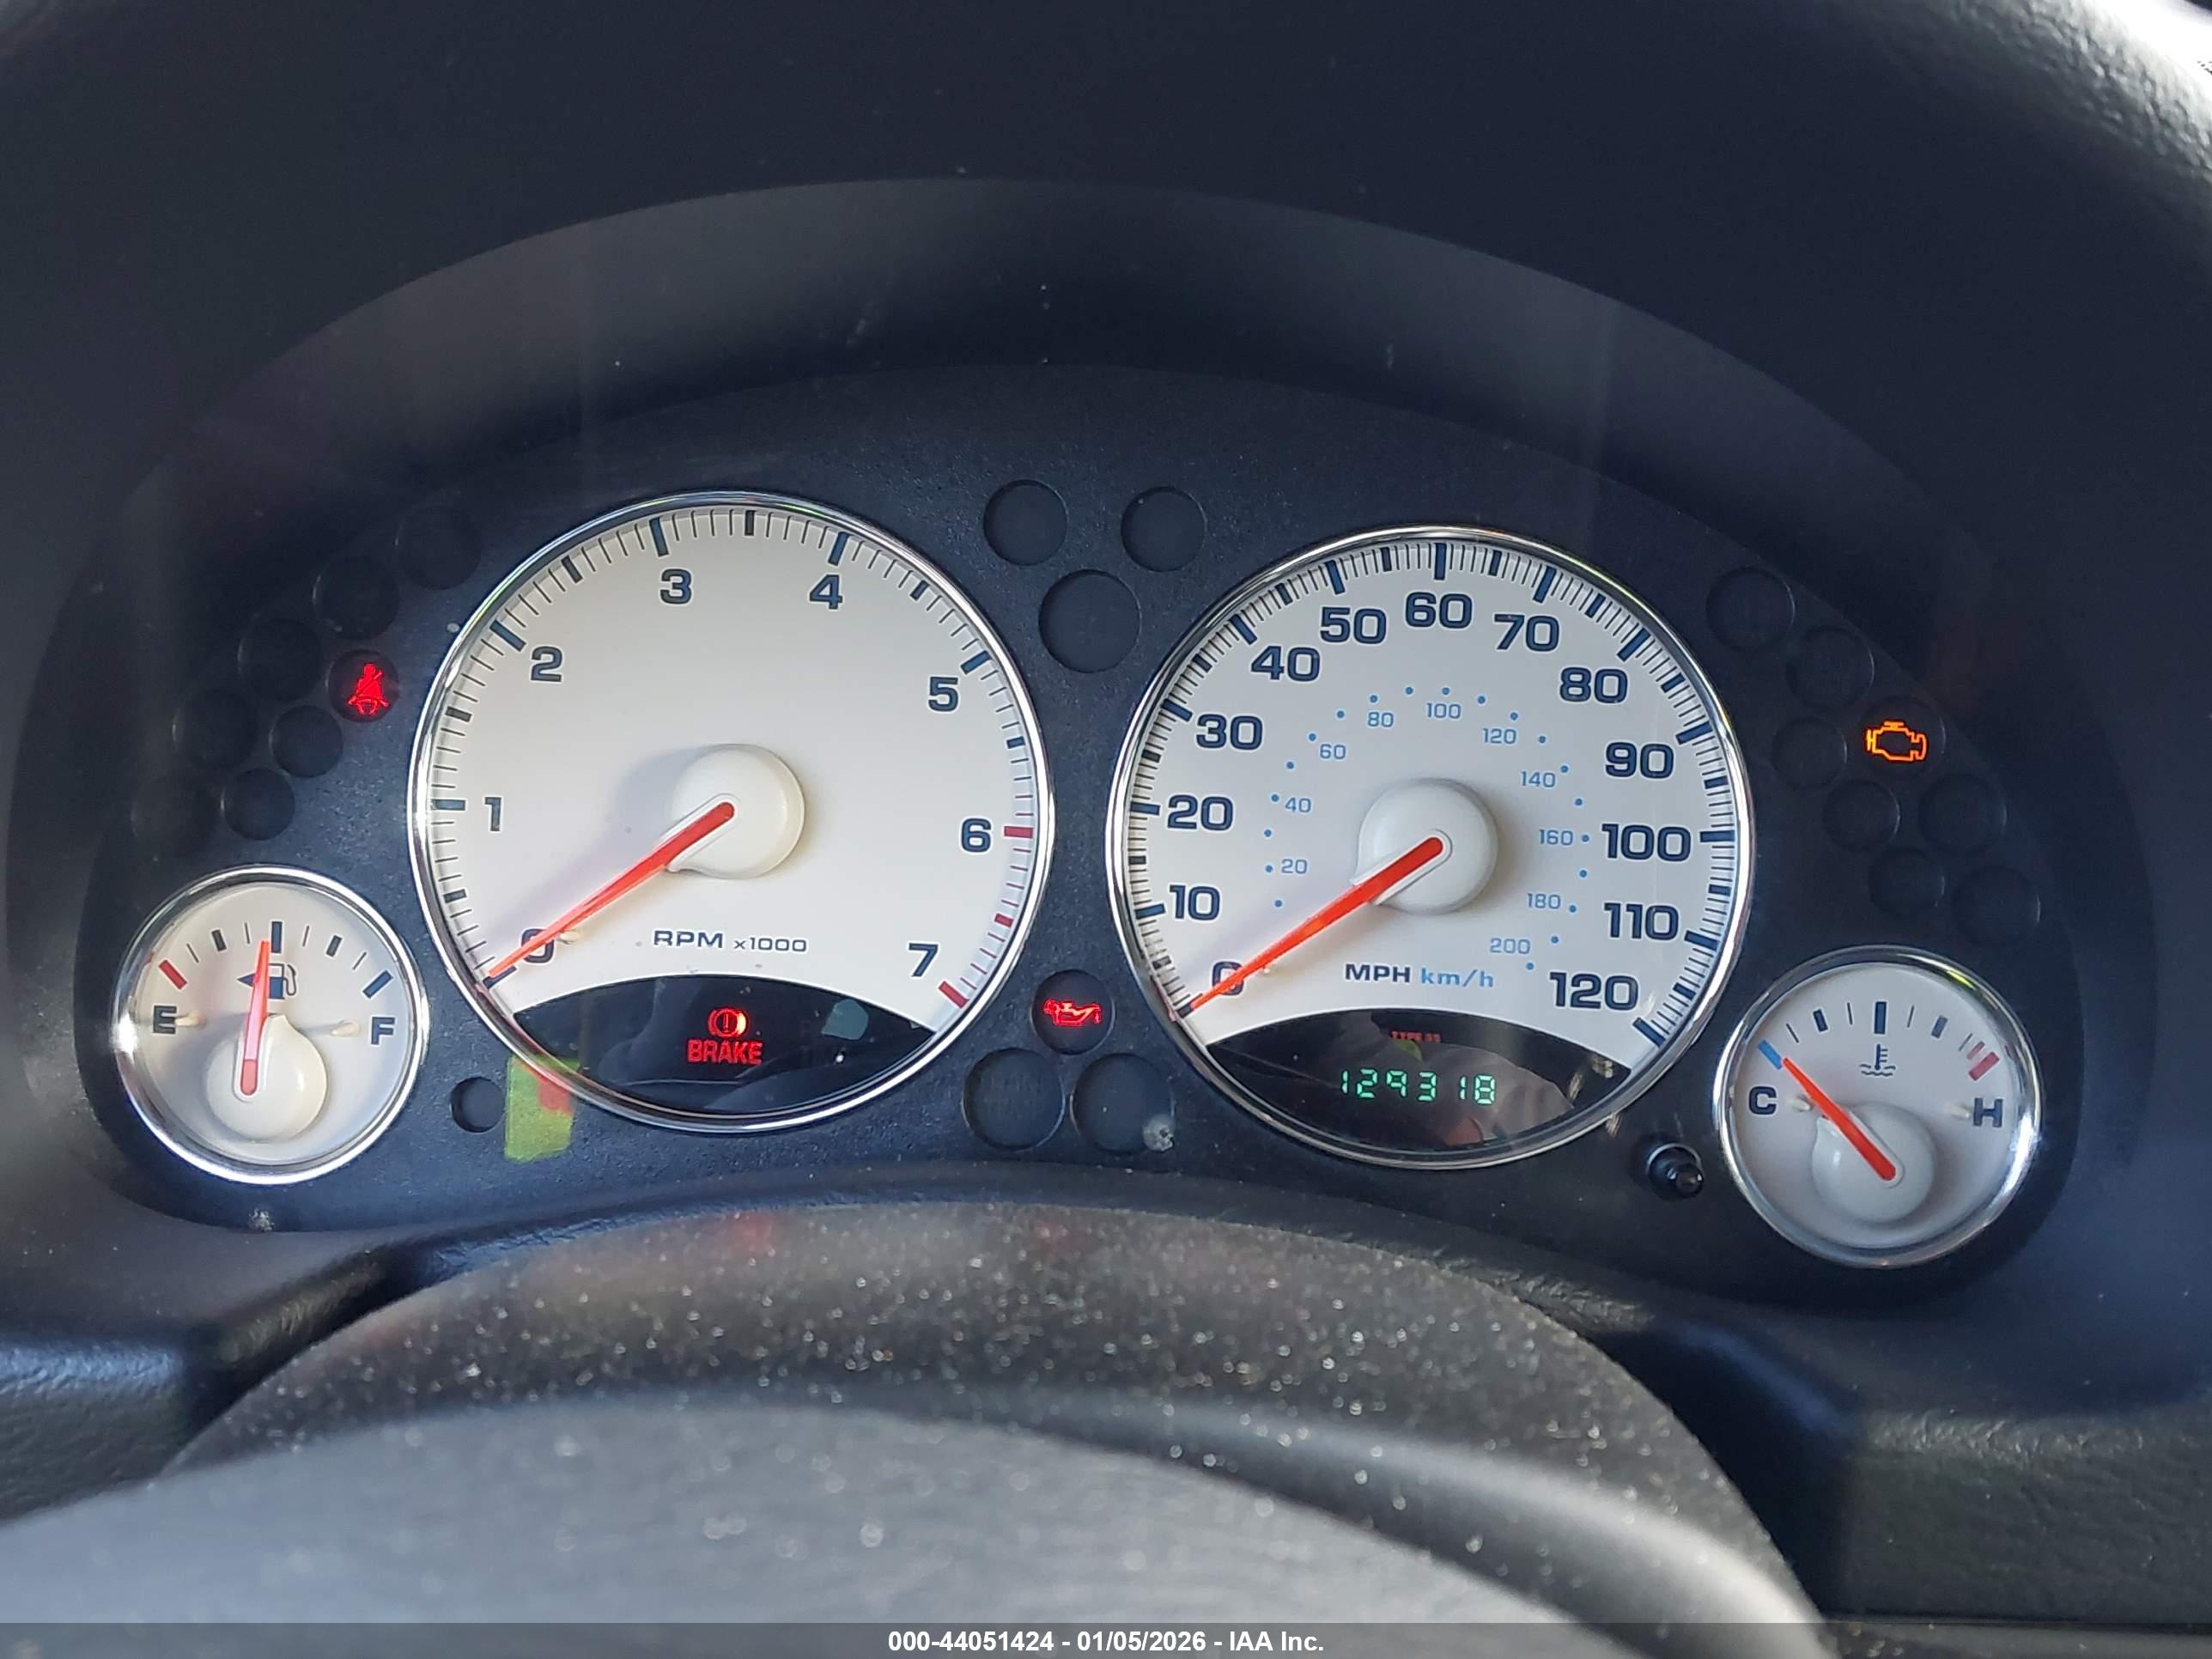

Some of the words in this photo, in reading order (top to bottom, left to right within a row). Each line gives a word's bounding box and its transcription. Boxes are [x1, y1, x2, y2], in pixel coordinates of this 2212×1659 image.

[660, 568, 691, 605] 3
[810, 574, 842, 610] 4
[1321, 607, 1386, 644] 50
[1406, 592, 1472, 629] 60
[1495, 614, 1559, 652] 70
[531, 646, 562, 682] 2
[1249, 646, 1320, 682] 40
[928, 677, 958, 712] 5
[1559, 667, 1627, 703] 80
[1368, 712, 1394, 727] 80
[1427, 703, 1461, 719] 100
[1196, 714, 1262, 750] 30
[1484, 728, 1516, 744] 120
[1320, 744, 1346, 759] 60
[1606, 742, 1674, 779] 90
[1522, 771, 1555, 787] 140
[485, 797, 501, 831] 1
[1168, 795, 1233, 830] 20
[1285, 798, 1311, 812] 40
[962, 818, 991, 852] 6
[1539, 830, 1573, 845] 160
[1602, 823, 1691, 861] 100
[1281, 859, 1307, 874] 20
[1170, 885, 1220, 921] 10
[1528, 893, 1560, 909] 180
[1604, 902, 1679, 940] 110
[521, 930, 555, 963] 0
[654, 931, 722, 948] RPM
[734, 938, 806, 951] x1000
[1490, 938, 1530, 954] 200
[909, 943, 938, 976] 7
[1346, 964, 1410, 982] MPH
[1421, 968, 1492, 987] km/h
[1212, 962, 1244, 995] 0
[1550, 972, 1638, 1011] 120
[153, 1006, 176, 1034] E
[371, 1017, 395, 1044] F
[688, 1039, 763, 1064] BRAKE
[1340, 1068, 1496, 1105] 129318
[1749, 1086, 1776, 1115] C
[1973, 1098, 2002, 1127] H
